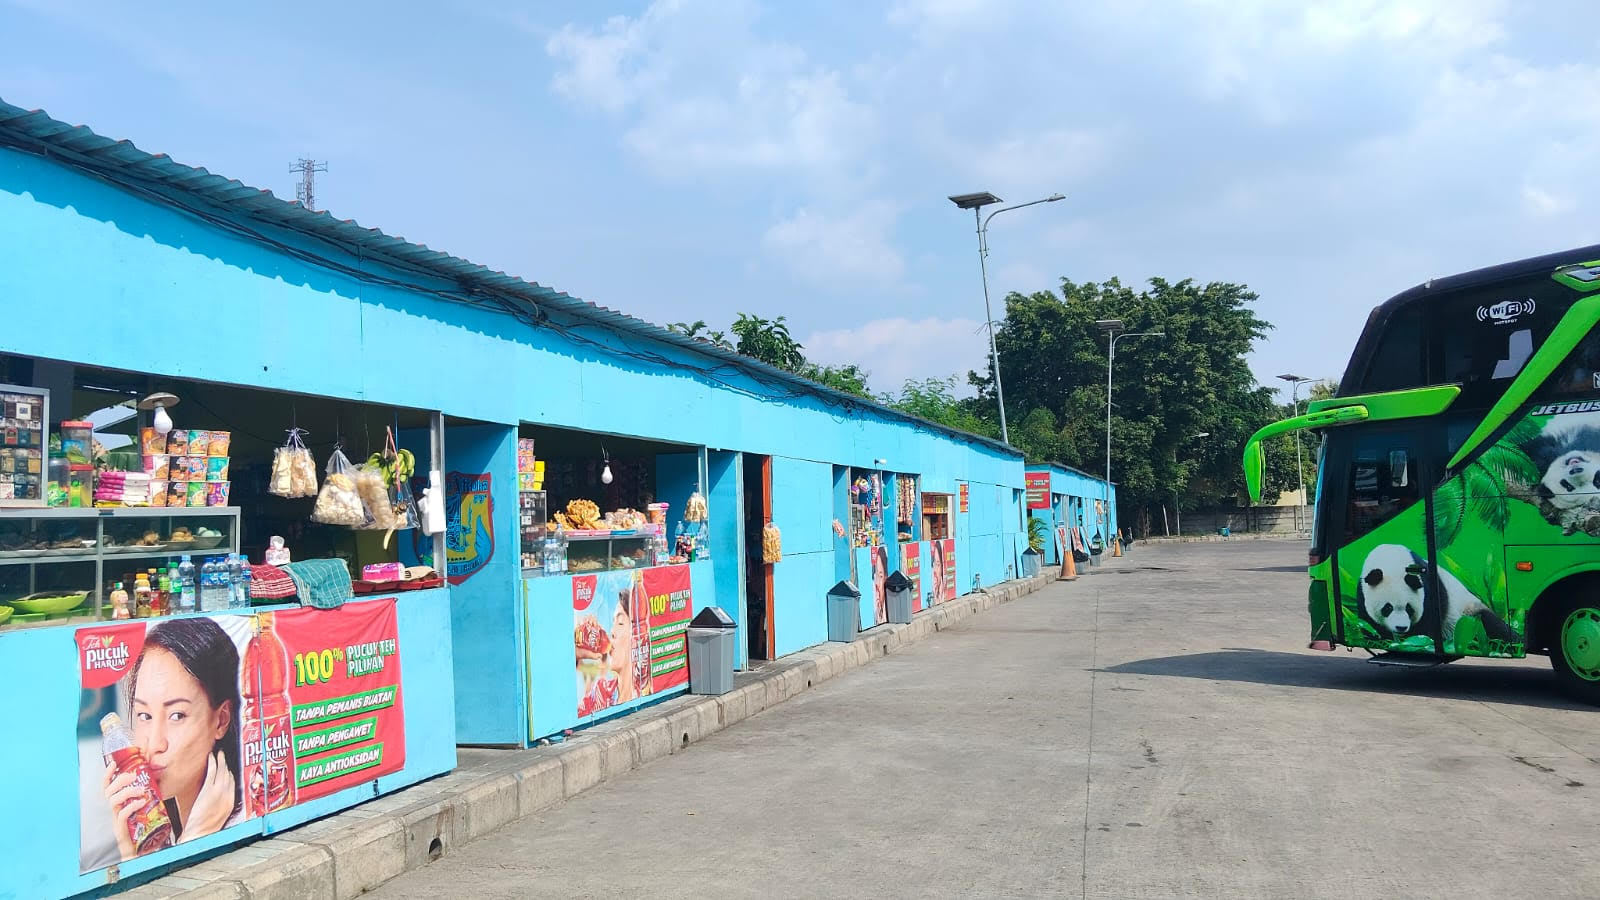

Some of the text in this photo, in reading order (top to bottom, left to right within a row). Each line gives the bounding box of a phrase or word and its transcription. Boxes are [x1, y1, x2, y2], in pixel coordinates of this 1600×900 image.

[346, 638, 396, 660] PUCUK TEH
[94, 658, 127, 671] HARUM
[294, 647, 344, 687] 100%
[347, 655, 385, 678] PILIHAN
[296, 690, 393, 721] TANPA PEMANIS BUATAN
[297, 723, 373, 752] TANPA PENGAWET
[300, 749, 380, 782] KAYA ANTIOKSIDAN
